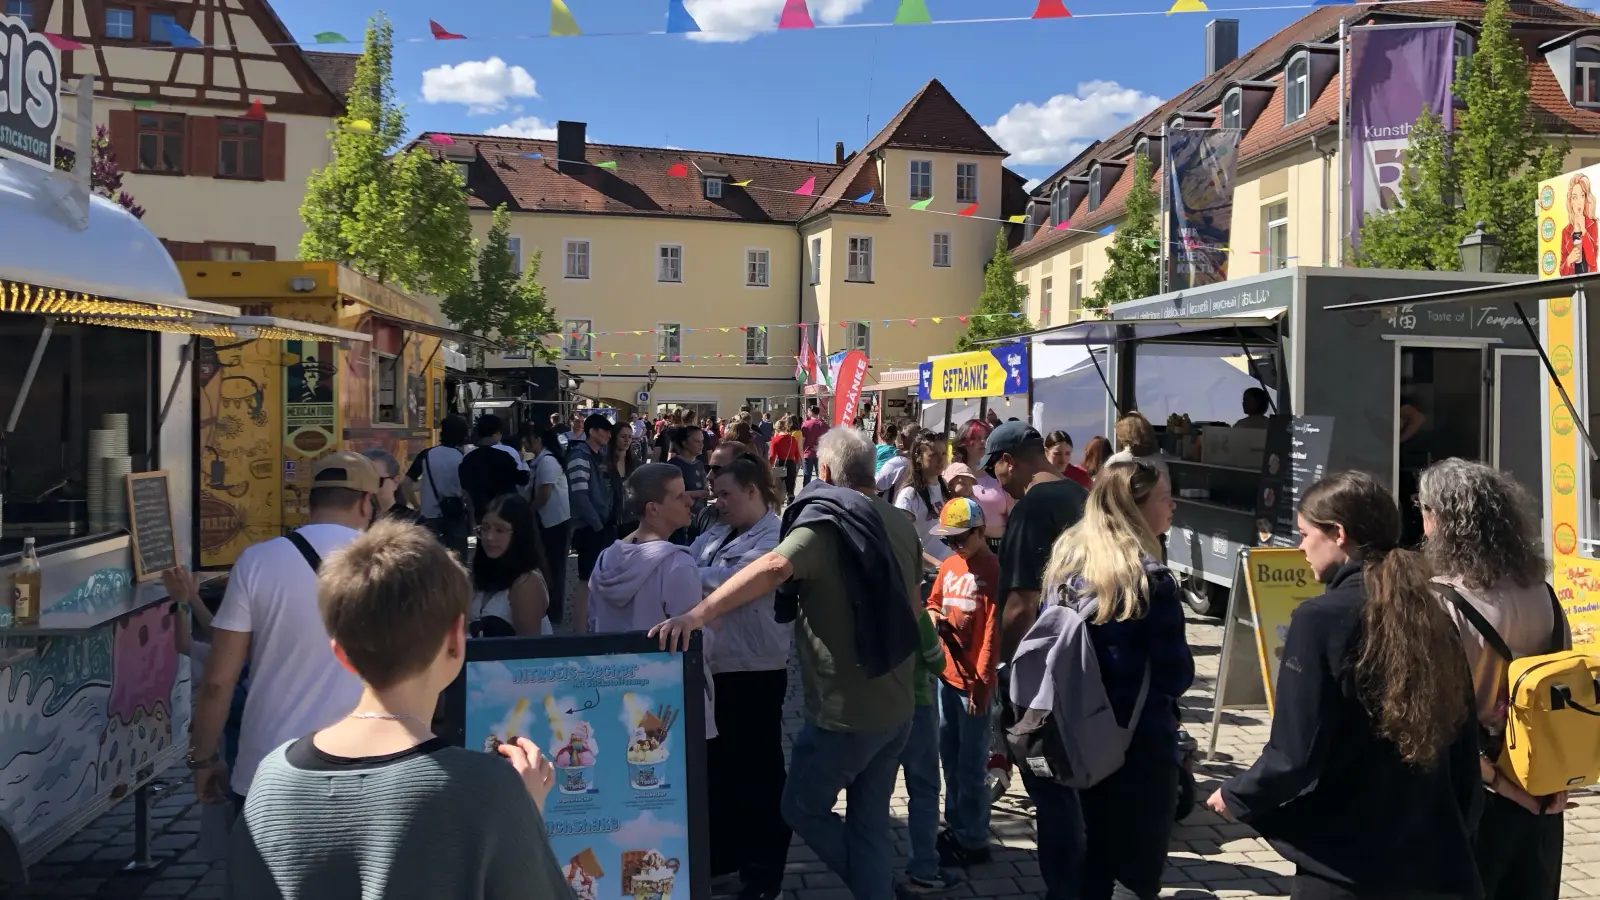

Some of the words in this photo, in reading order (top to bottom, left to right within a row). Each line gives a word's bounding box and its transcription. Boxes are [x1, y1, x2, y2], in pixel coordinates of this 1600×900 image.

[1364, 121, 1414, 138] Kunsth
[1427, 310, 1452, 322] Taste
[1455, 312, 1465, 322] of
[1476, 306, 1540, 328] Tempua
[943, 361, 989, 393] GETRÄNKE
[840, 358, 867, 429] ETRÄNKE
[1573, 602, 1600, 614] Sandwi
